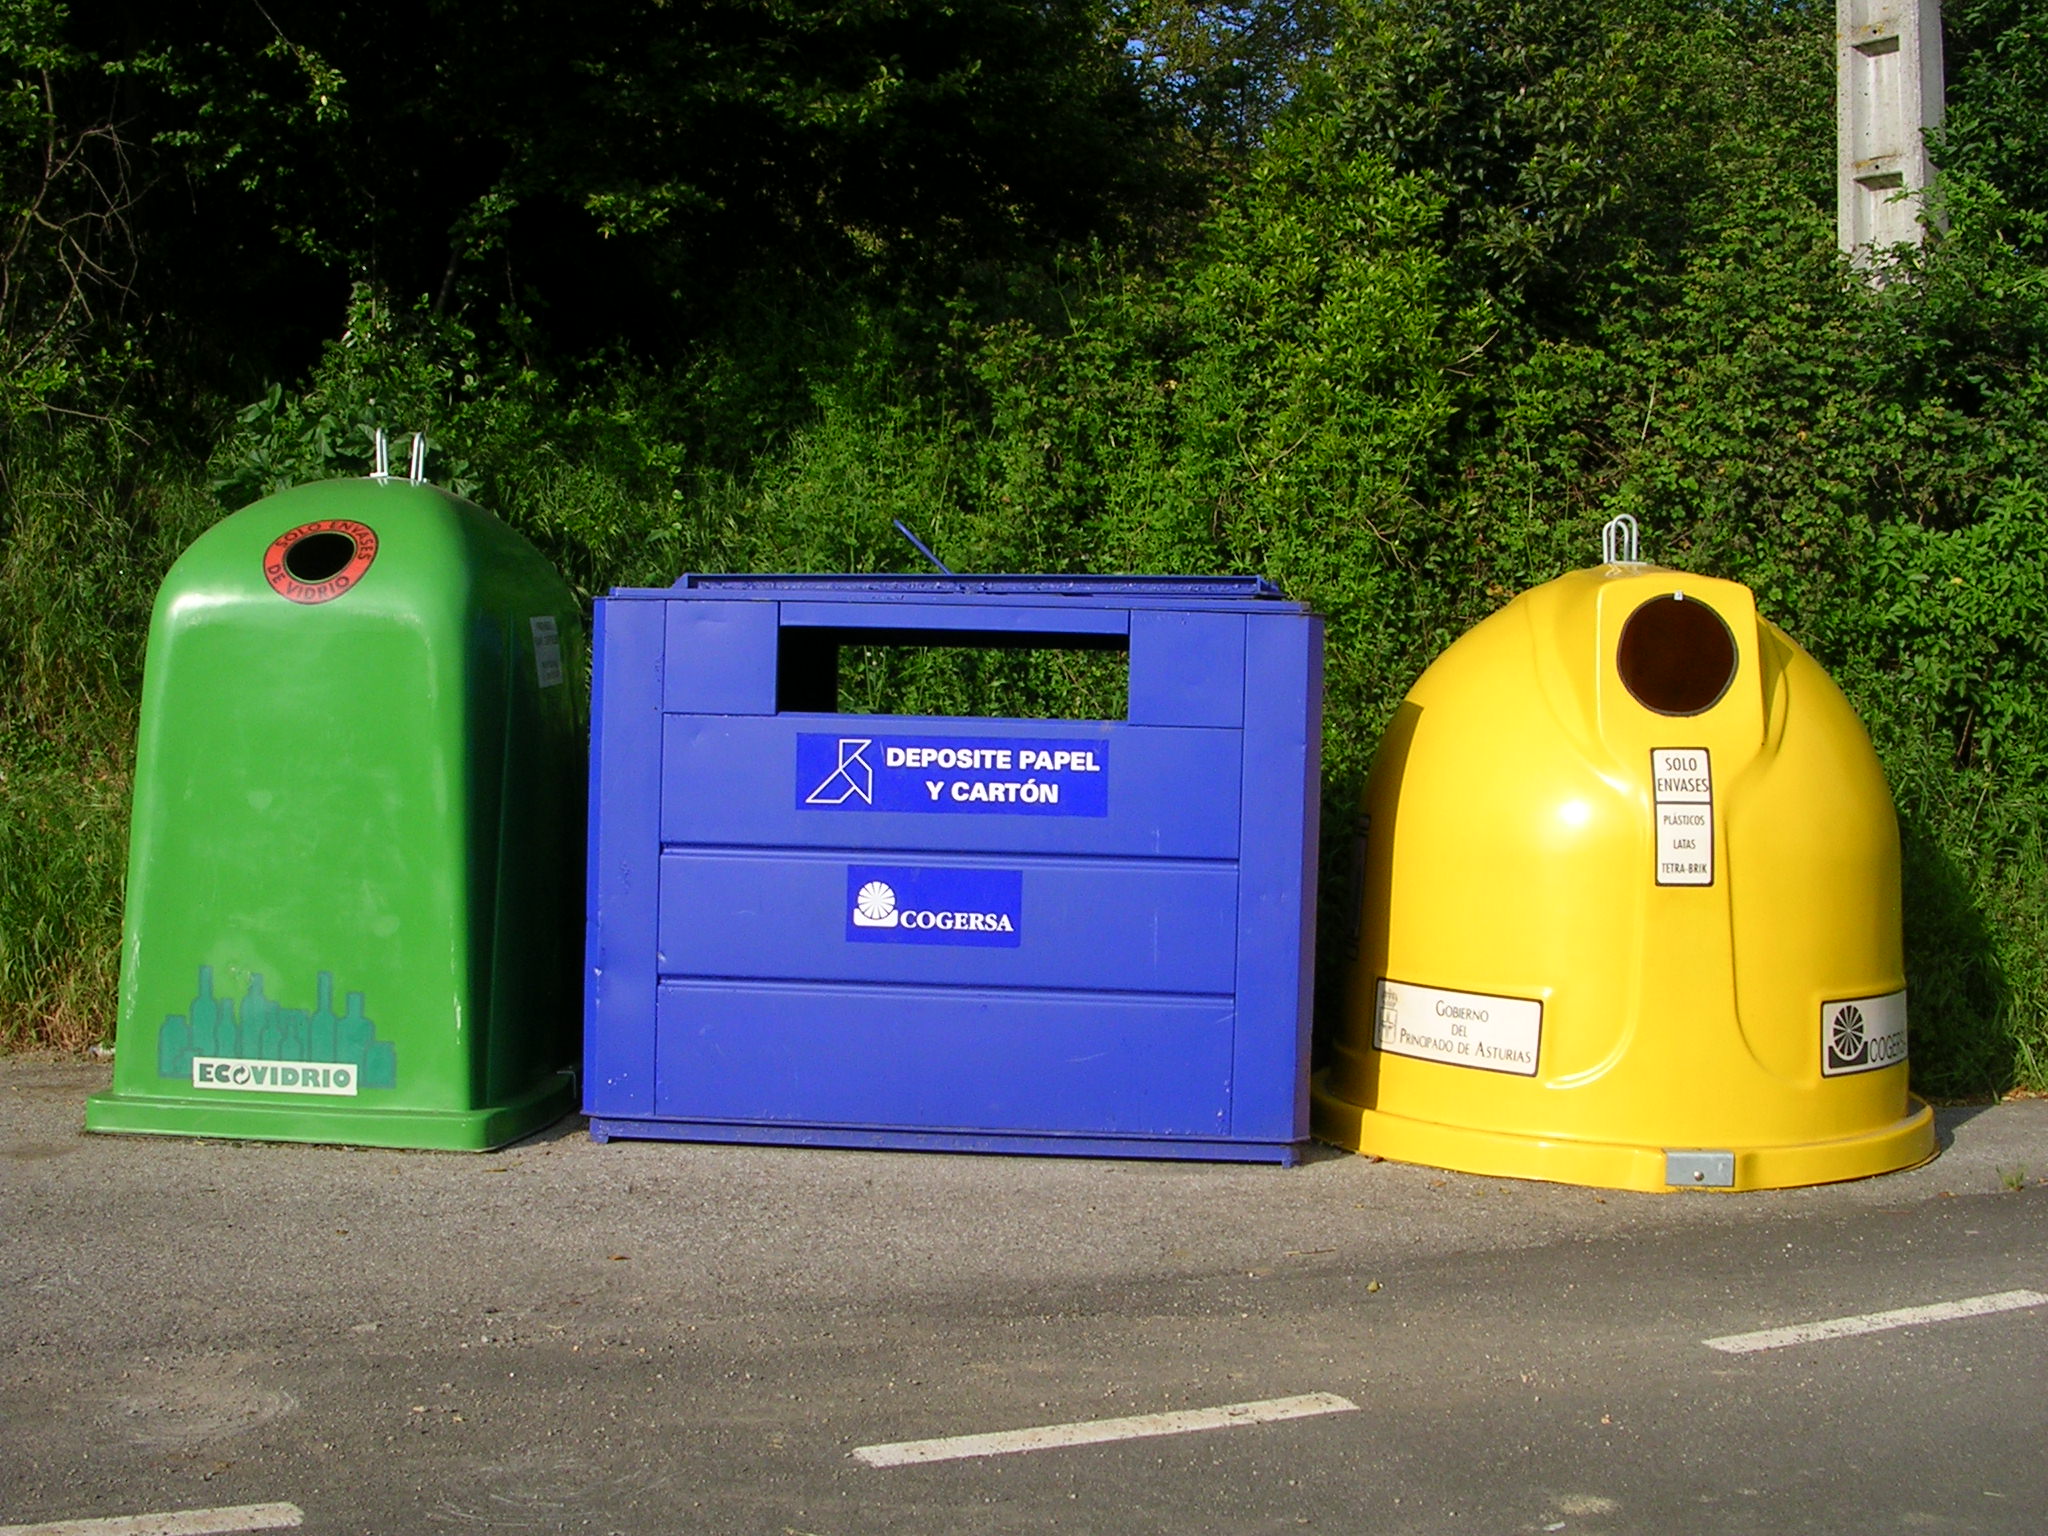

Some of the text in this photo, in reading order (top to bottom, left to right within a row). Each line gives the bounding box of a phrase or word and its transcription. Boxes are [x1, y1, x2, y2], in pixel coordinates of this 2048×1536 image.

[275, 521, 374, 560] SOLO ENVASES
[267, 563, 350, 599] DE VIDRIO
[886, 747, 1100, 771] DEPOSITE PAPEL
[1665, 757, 1697, 771] SOLO
[926, 778, 1059, 804] Y CARTÓN
[1657, 778, 1709, 793] ENVASES
[1663, 813, 1705, 826] PLÁSTICOS
[1673, 839, 1696, 850] LATAS
[1662, 862, 1707, 874] TETRA-BRIK
[900, 910, 1014, 932] COGERSA
